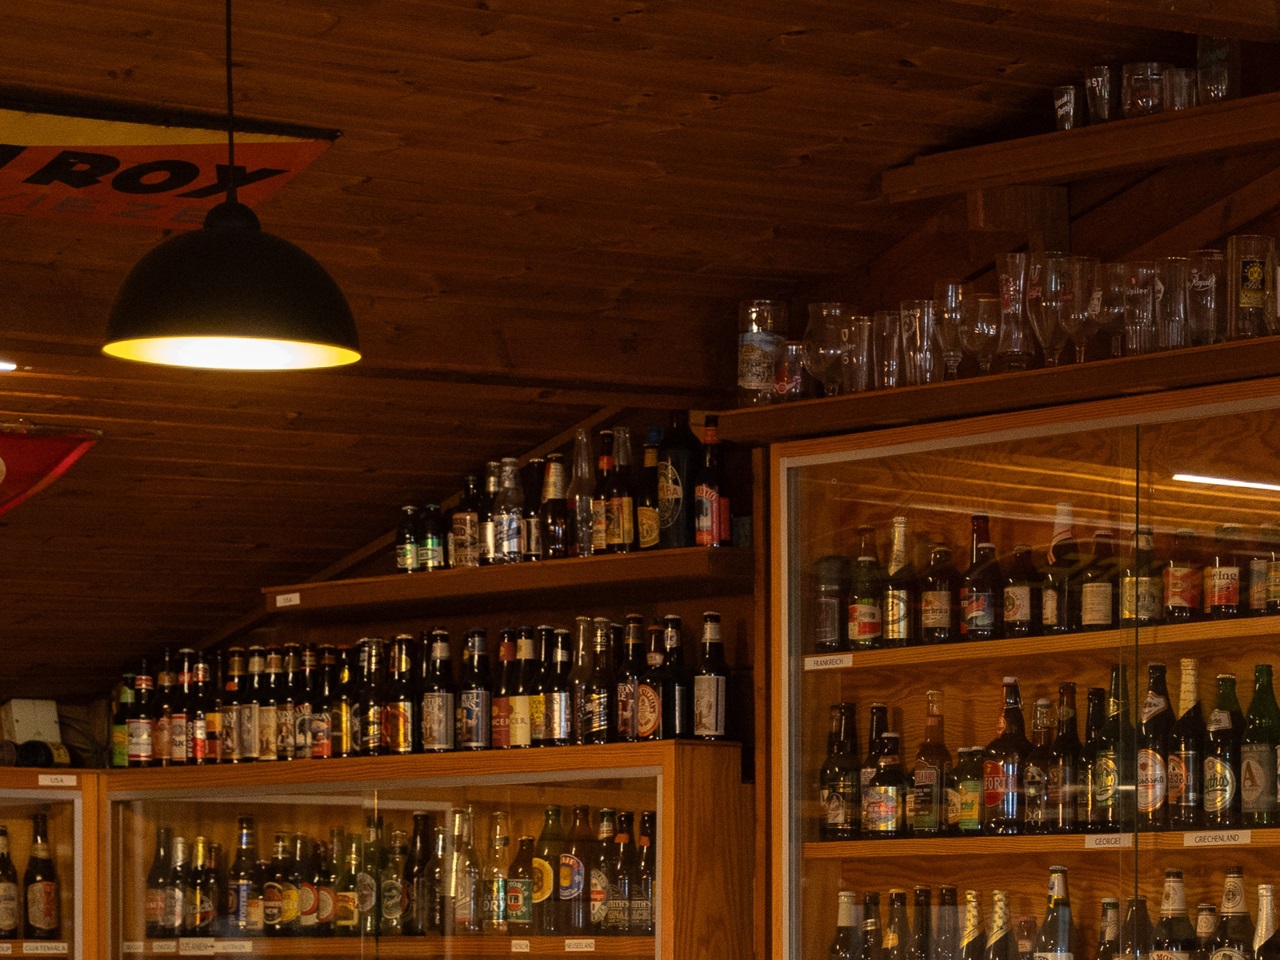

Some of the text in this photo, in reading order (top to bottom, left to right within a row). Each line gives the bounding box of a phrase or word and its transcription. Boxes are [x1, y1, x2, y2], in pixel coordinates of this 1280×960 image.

[22, 150, 290, 199] ROX
[812, 658, 844, 668] FRANKREICH
[1194, 834, 1241, 845] GRIECHENLAND
